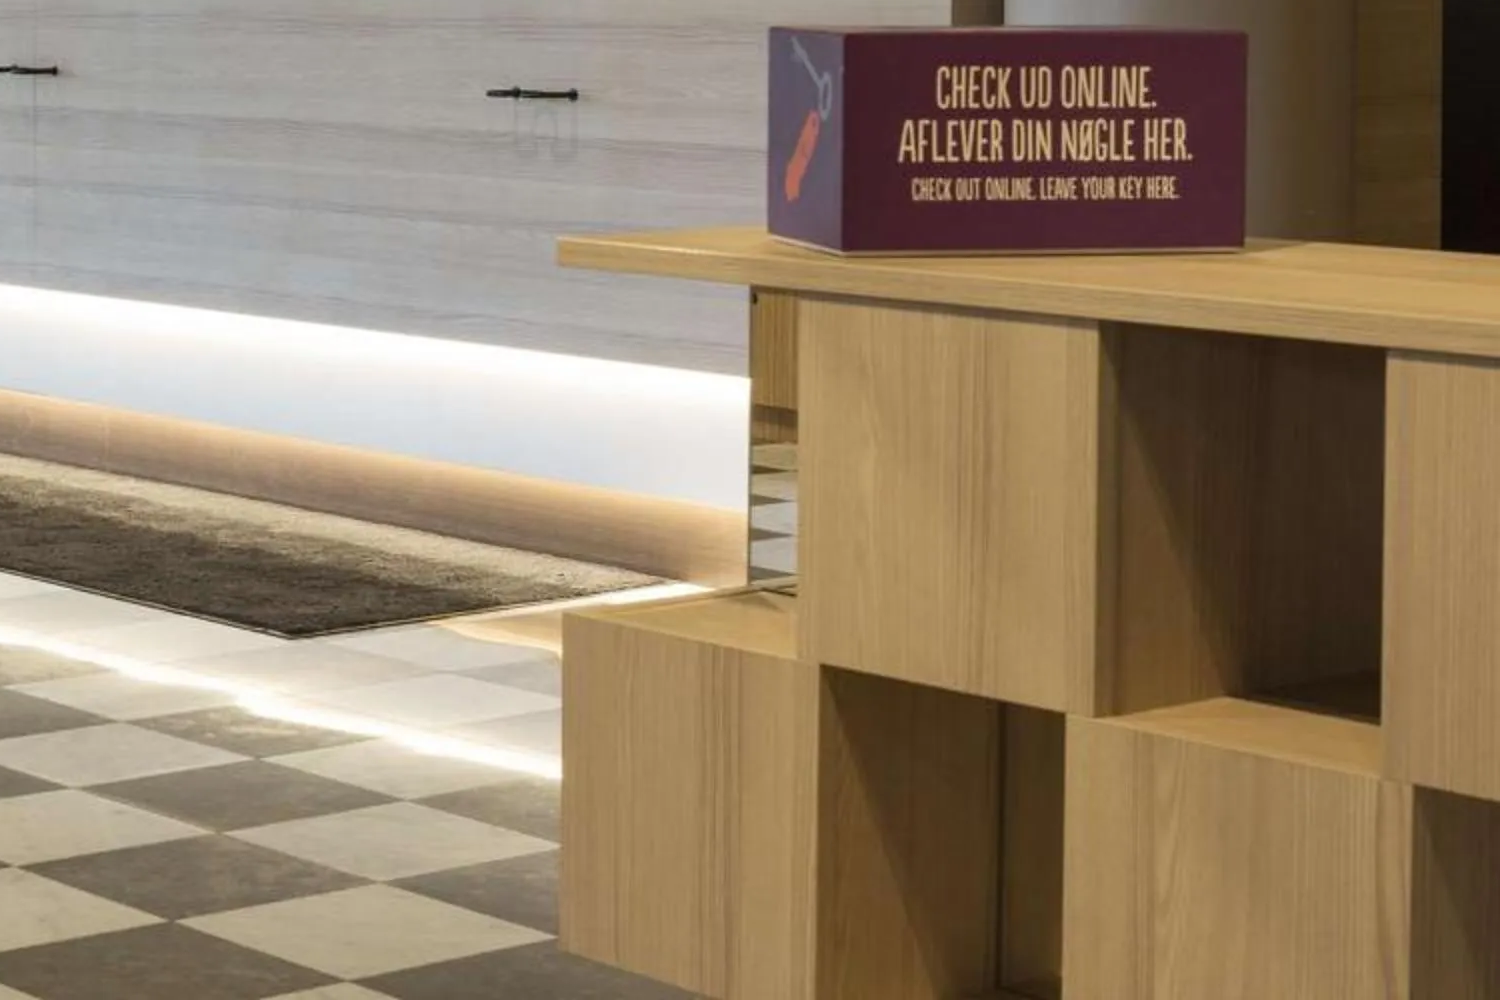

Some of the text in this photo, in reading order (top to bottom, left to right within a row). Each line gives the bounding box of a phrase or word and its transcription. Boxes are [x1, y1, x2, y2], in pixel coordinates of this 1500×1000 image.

[936, 66, 1157, 109] CHECK UD ONLINE.
[897, 118, 1193, 162] AFLEVER DIN NØGLE HER.
[911, 177, 952, 201] CHECK
[955, 177, 981, 201] OUT
[1041, 177, 1077, 201] LEAVE
[1081, 176, 1117, 200] YOUR
[1119, 176, 1143, 200] KEY
